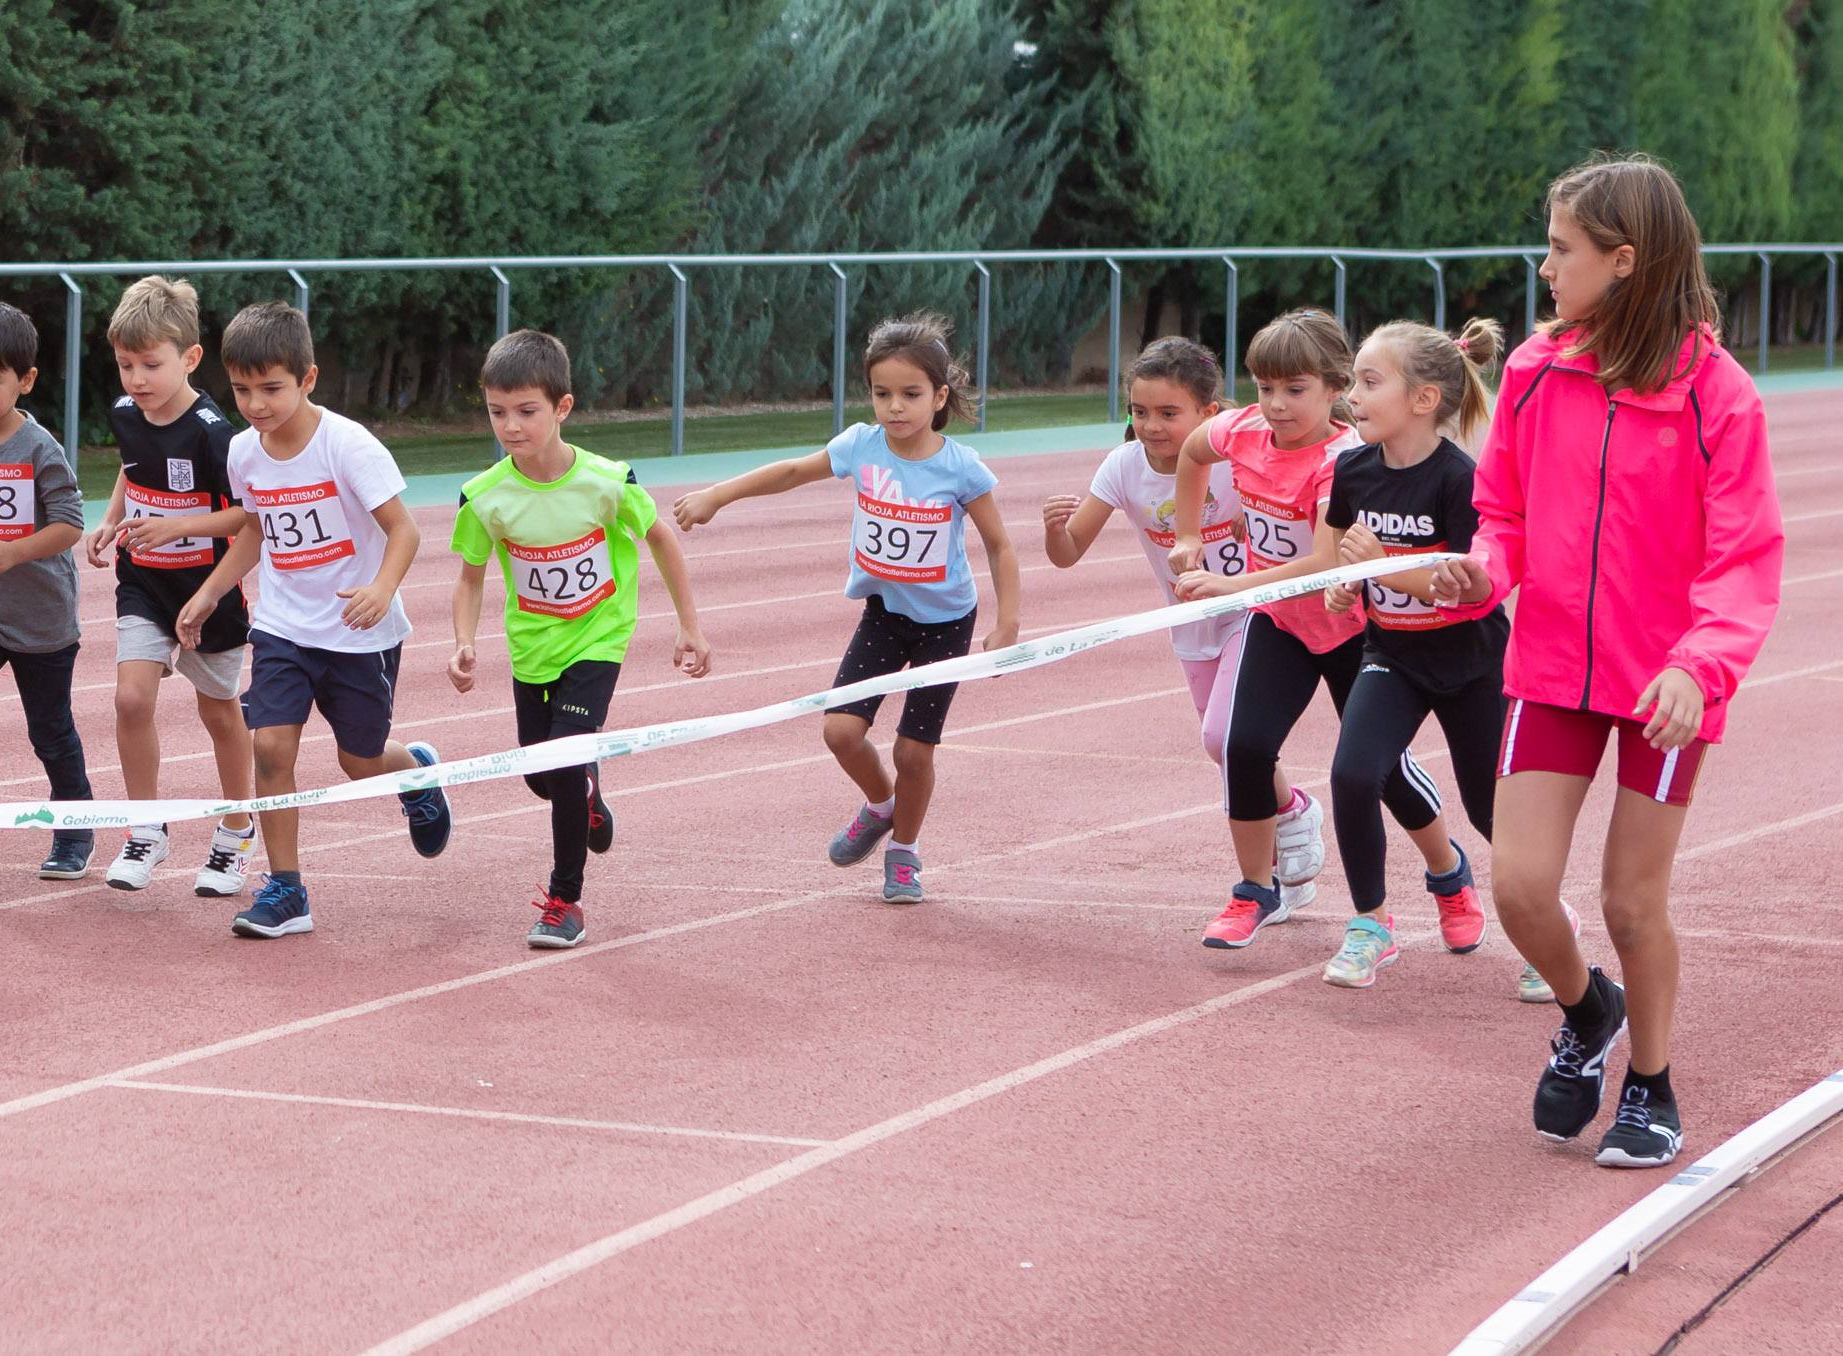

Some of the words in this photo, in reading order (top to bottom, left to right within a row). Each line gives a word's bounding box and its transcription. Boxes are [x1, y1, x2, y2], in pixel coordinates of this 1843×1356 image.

[130, 489, 149, 503] RIOJA
[150, 496, 199, 508] ATLETISMO
[278, 489, 325, 504] ATLETISMO
[860, 498, 867, 510] LA
[867, 502, 893, 517] RIOJA
[895, 510, 945, 521] ATLETISMO
[1256, 500, 1294, 519] ATLETISMO
[265, 508, 332, 549] 431
[1200, 526, 1232, 542] LETISM
[1358, 509, 1435, 537] ADIDAS
[519, 550, 545, 560] RIOJA
[547, 537, 595, 560] ATLETISMO
[865, 521, 938, 563] 397
[529, 557, 598, 600] 428
[62, 814, 128, 826] Gobierno
